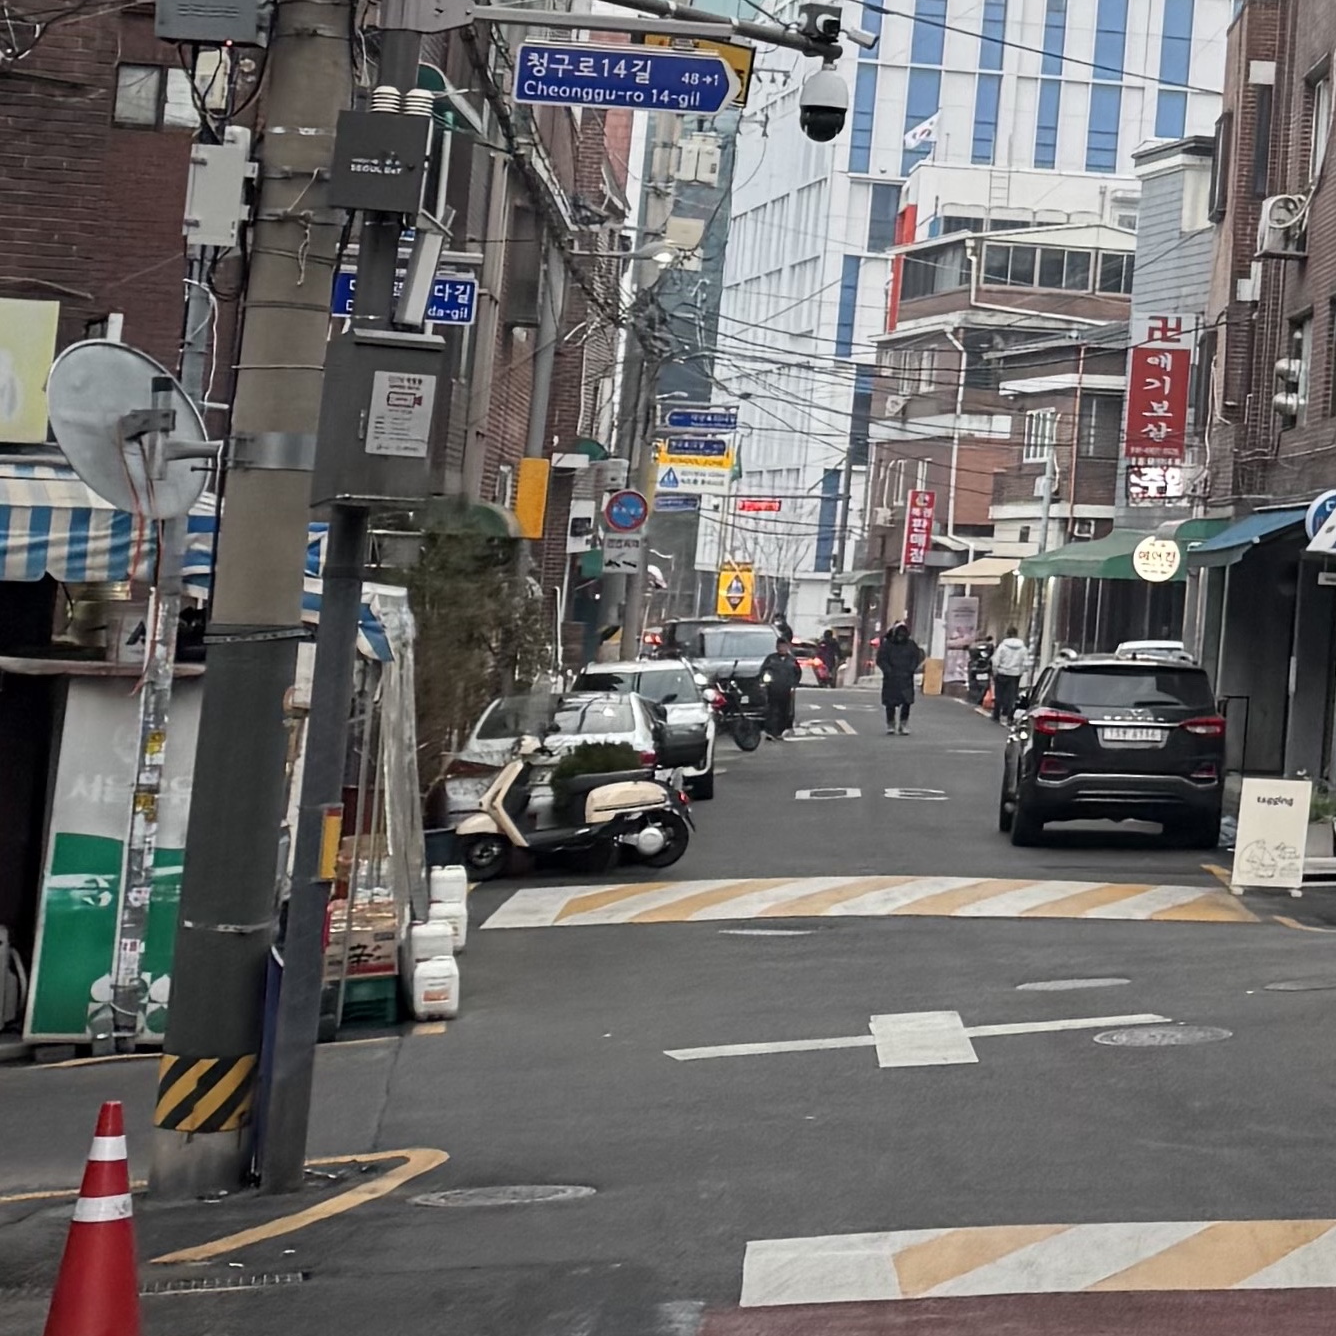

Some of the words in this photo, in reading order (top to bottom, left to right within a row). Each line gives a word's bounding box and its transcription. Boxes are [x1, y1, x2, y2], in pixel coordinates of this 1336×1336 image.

[527, 51, 652, 84] 청구로14길
[681, 71, 699, 85] 48
[523, 80, 645, 103] Cheonggu-ro
[651, 88, 700, 107] 14-gil
[1141, 352, 1174, 443] 애기보살
